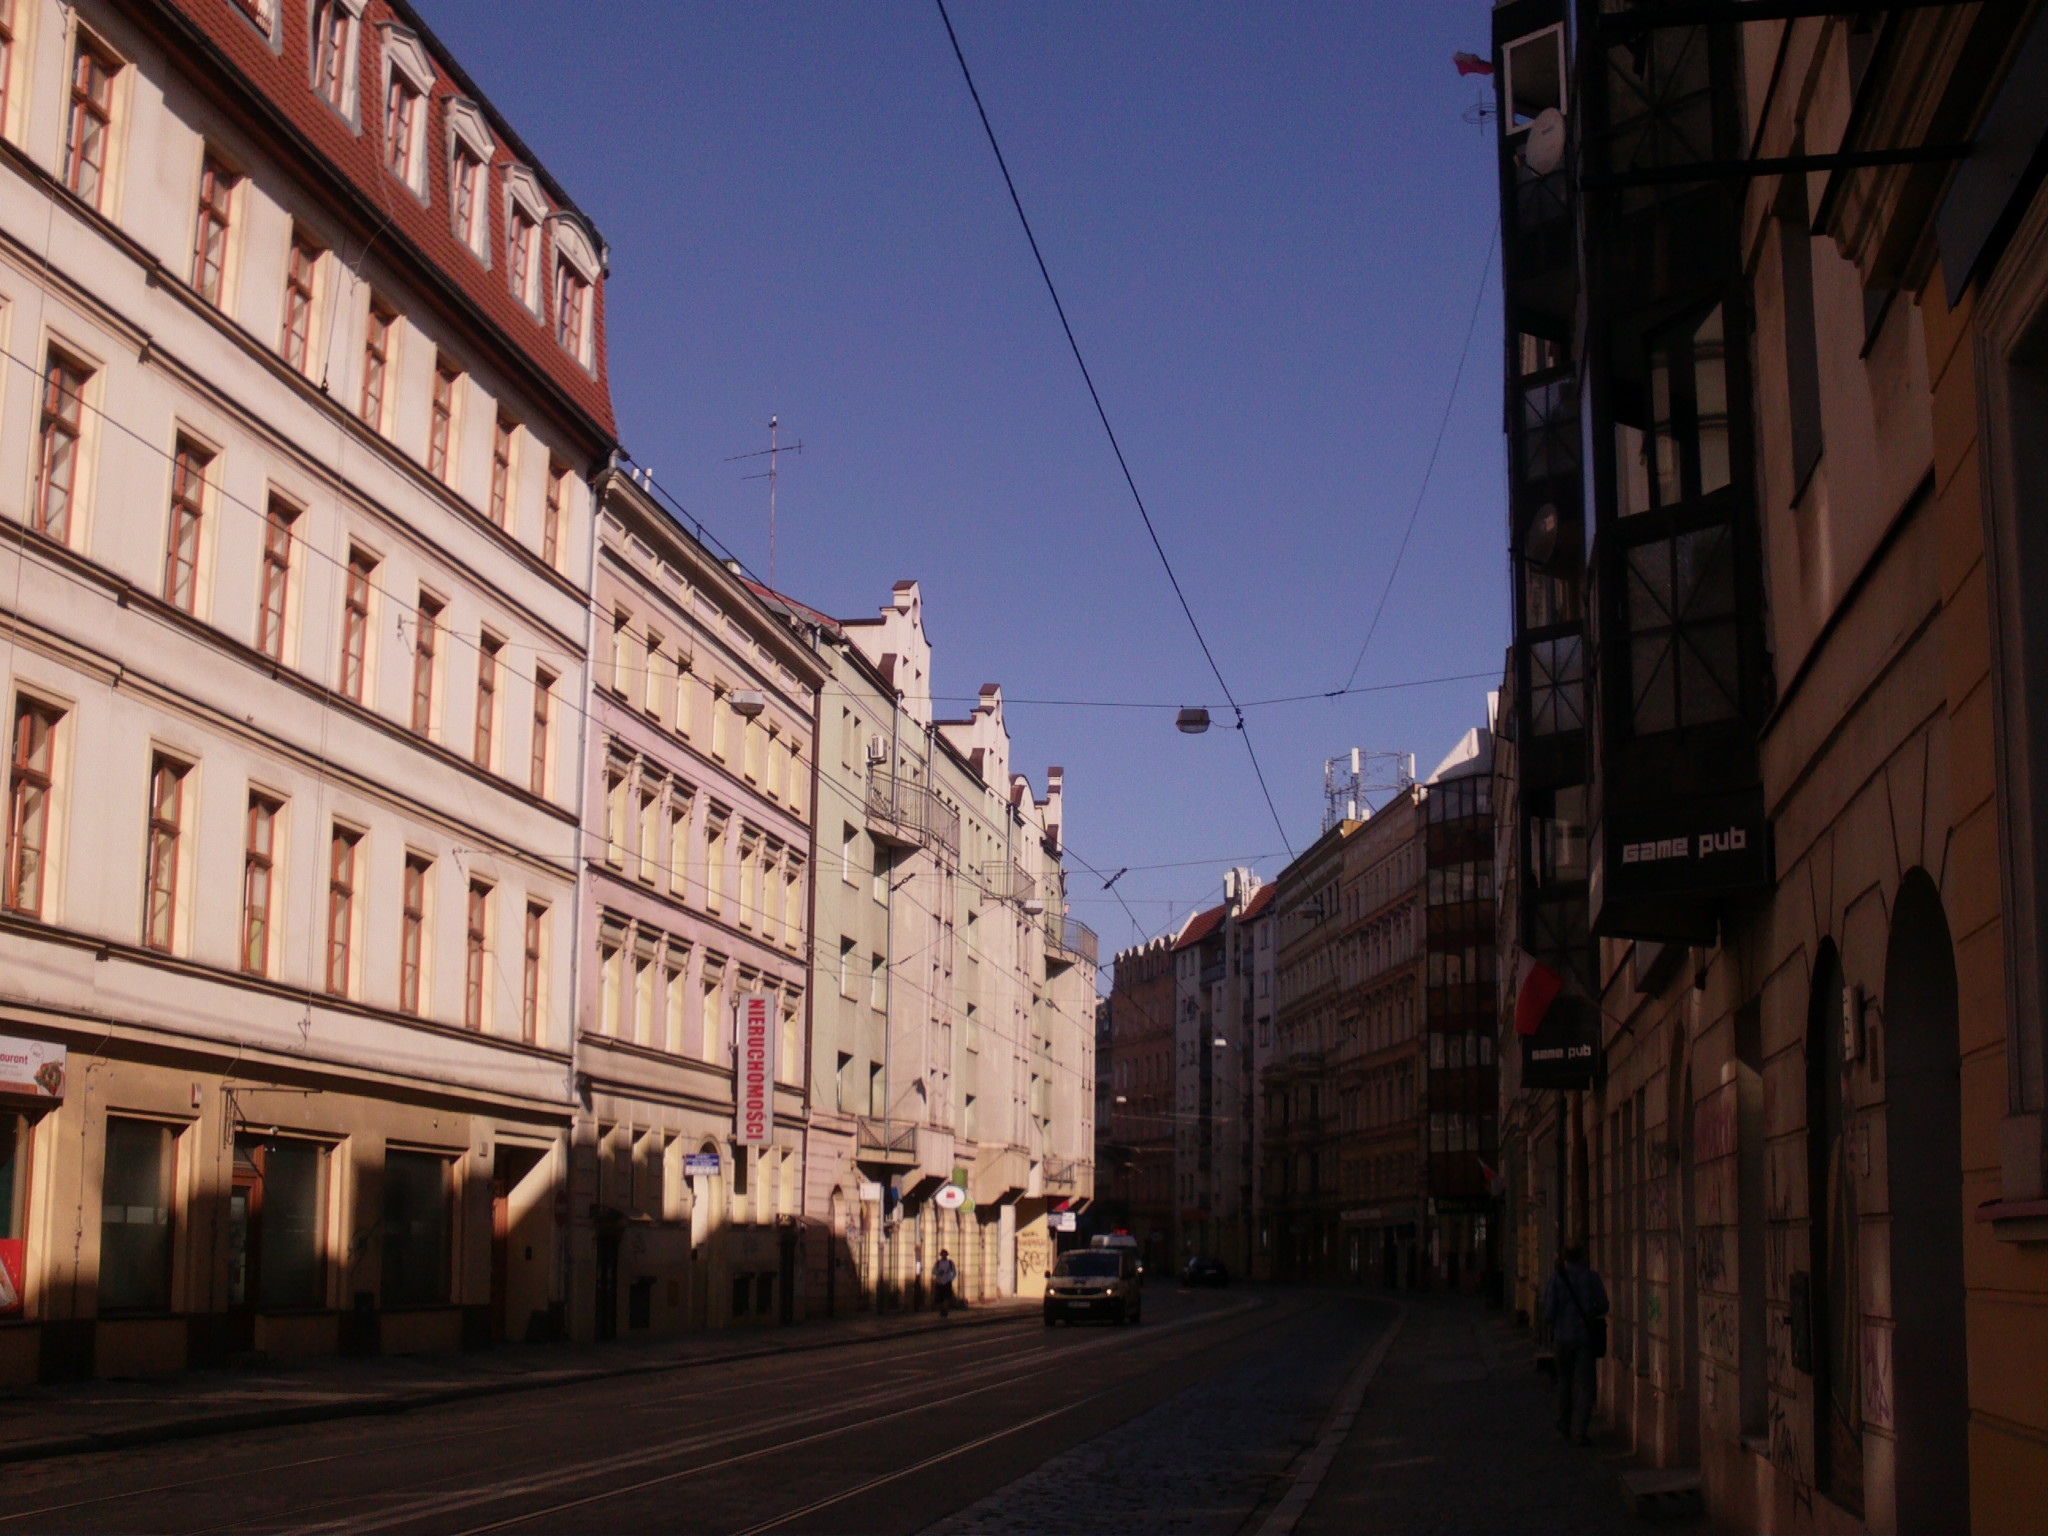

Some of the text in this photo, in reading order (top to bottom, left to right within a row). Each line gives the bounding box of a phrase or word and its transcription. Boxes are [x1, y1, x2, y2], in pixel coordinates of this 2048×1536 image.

[1698, 824, 1747, 860] pub
[746, 999, 767, 1140] NIERUCHOMOŚCI
[1568, 1044, 1592, 1060] pub
